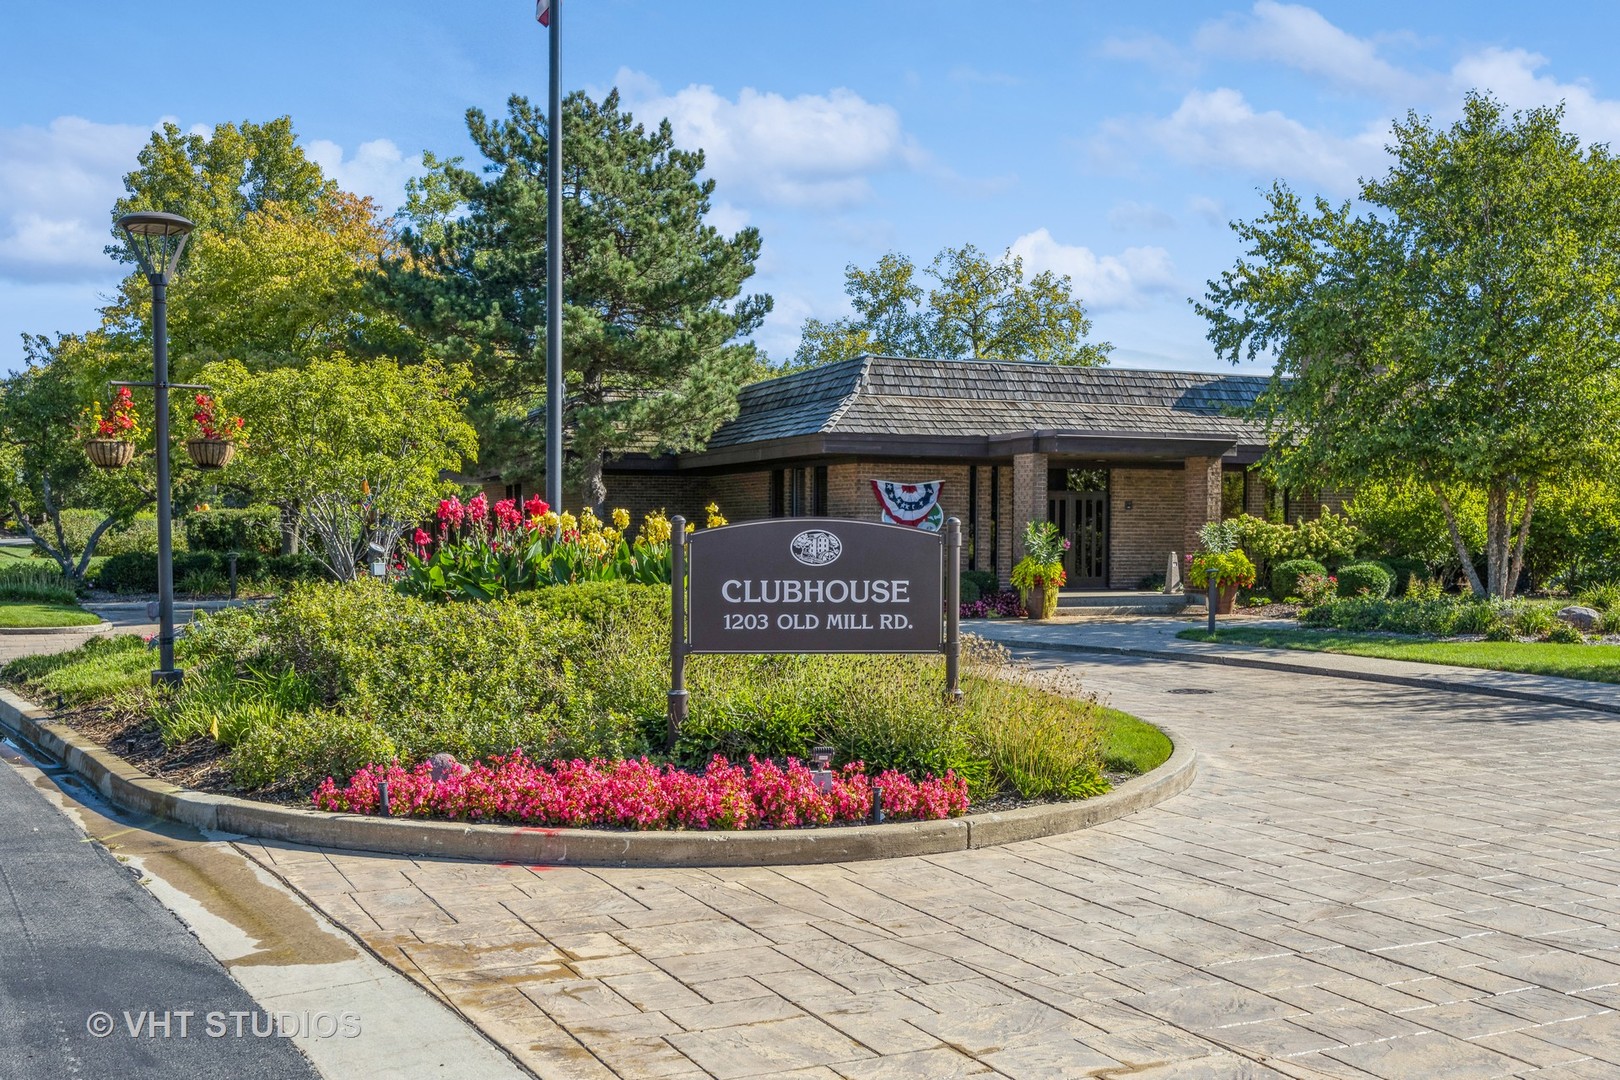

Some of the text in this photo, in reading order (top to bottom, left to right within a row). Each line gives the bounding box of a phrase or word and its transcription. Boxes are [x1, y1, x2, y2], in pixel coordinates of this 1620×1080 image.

[721, 579, 910, 603] CLUBHOUSE
[723, 614, 914, 630] 1203 OLD MILL RD.
